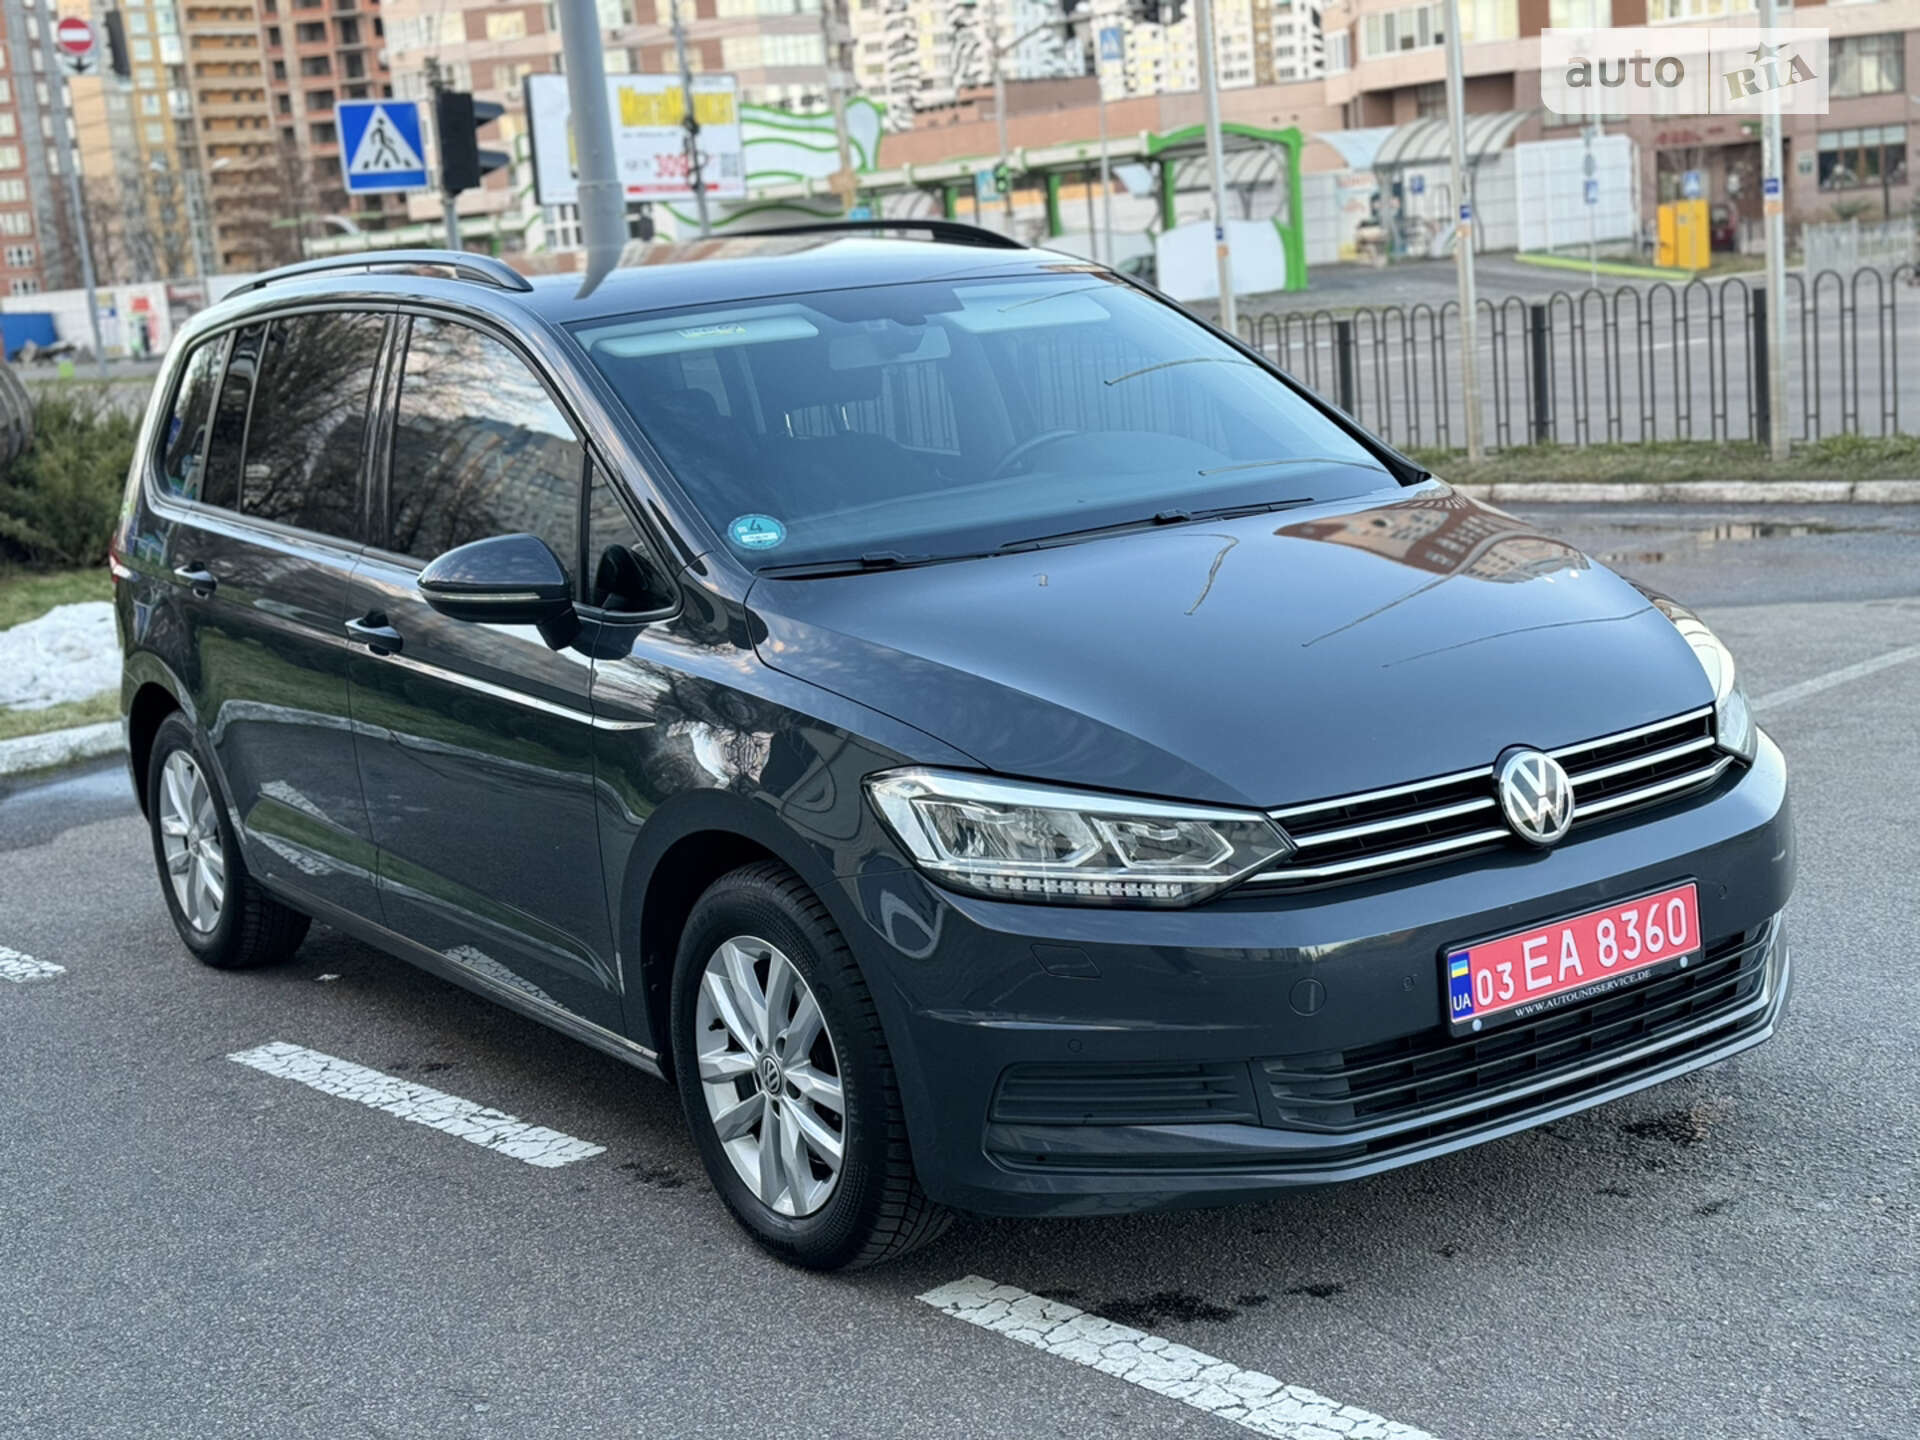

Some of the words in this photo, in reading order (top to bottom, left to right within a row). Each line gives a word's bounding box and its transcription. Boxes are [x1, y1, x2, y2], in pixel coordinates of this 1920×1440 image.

[1476, 961, 1515, 1007] 03
[1522, 928, 1584, 991] EA
[1597, 897, 1688, 968] 8360
[1453, 993, 1472, 1012] UA
[1514, 968, 1652, 1018] WWW.AUTOUNDSERVICE.DE
